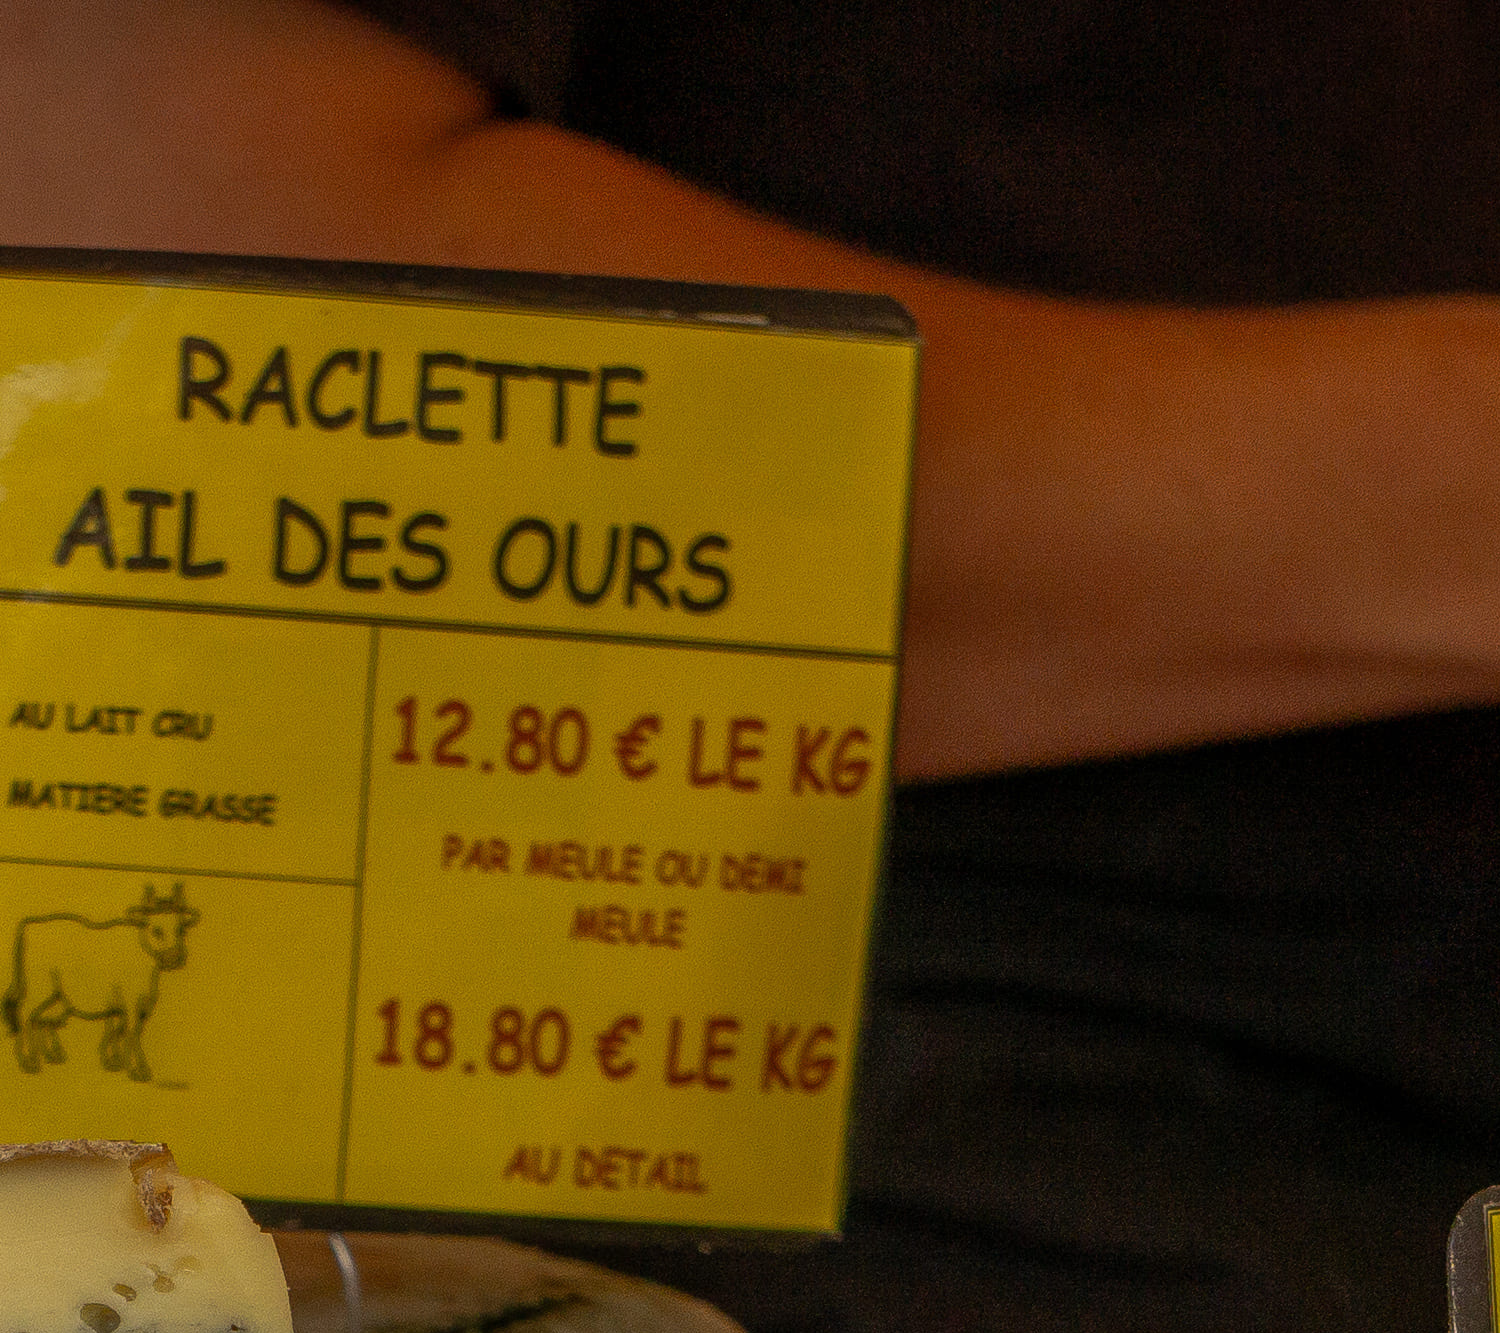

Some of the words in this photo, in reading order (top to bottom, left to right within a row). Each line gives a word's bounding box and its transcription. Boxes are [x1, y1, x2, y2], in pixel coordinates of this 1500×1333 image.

[177, 335, 648, 460] RACLETTE
[54, 487, 229, 581] AIL
[272, 496, 451, 596] DES
[492, 516, 733, 616] OURS
[8, 701, 57, 732] AU
[64, 704, 144, 736] LAIT
[151, 709, 215, 743] CRU
[392, 695, 591, 778] 12.80
[613, 713, 662, 782] €
[687, 716, 768, 794] LE
[791, 725, 872, 799] KG
[6, 779, 150, 819] MATIERE
[158, 788, 278, 828] GRASSE
[441, 833, 512, 873] PAR
[524, 839, 645, 887] MEULE
[654, 849, 710, 890] OU
[720, 852, 808, 897] DEMI
[569, 903, 687, 950] MEULE
[375, 997, 572, 1078] 18.80
[594, 1013, 643, 1082] €
[664, 1014, 742, 1093] LE
[760, 1023, 838, 1095] KG
[502, 1146, 562, 1187] AU
[573, 1145, 709, 1197] DETAIL
